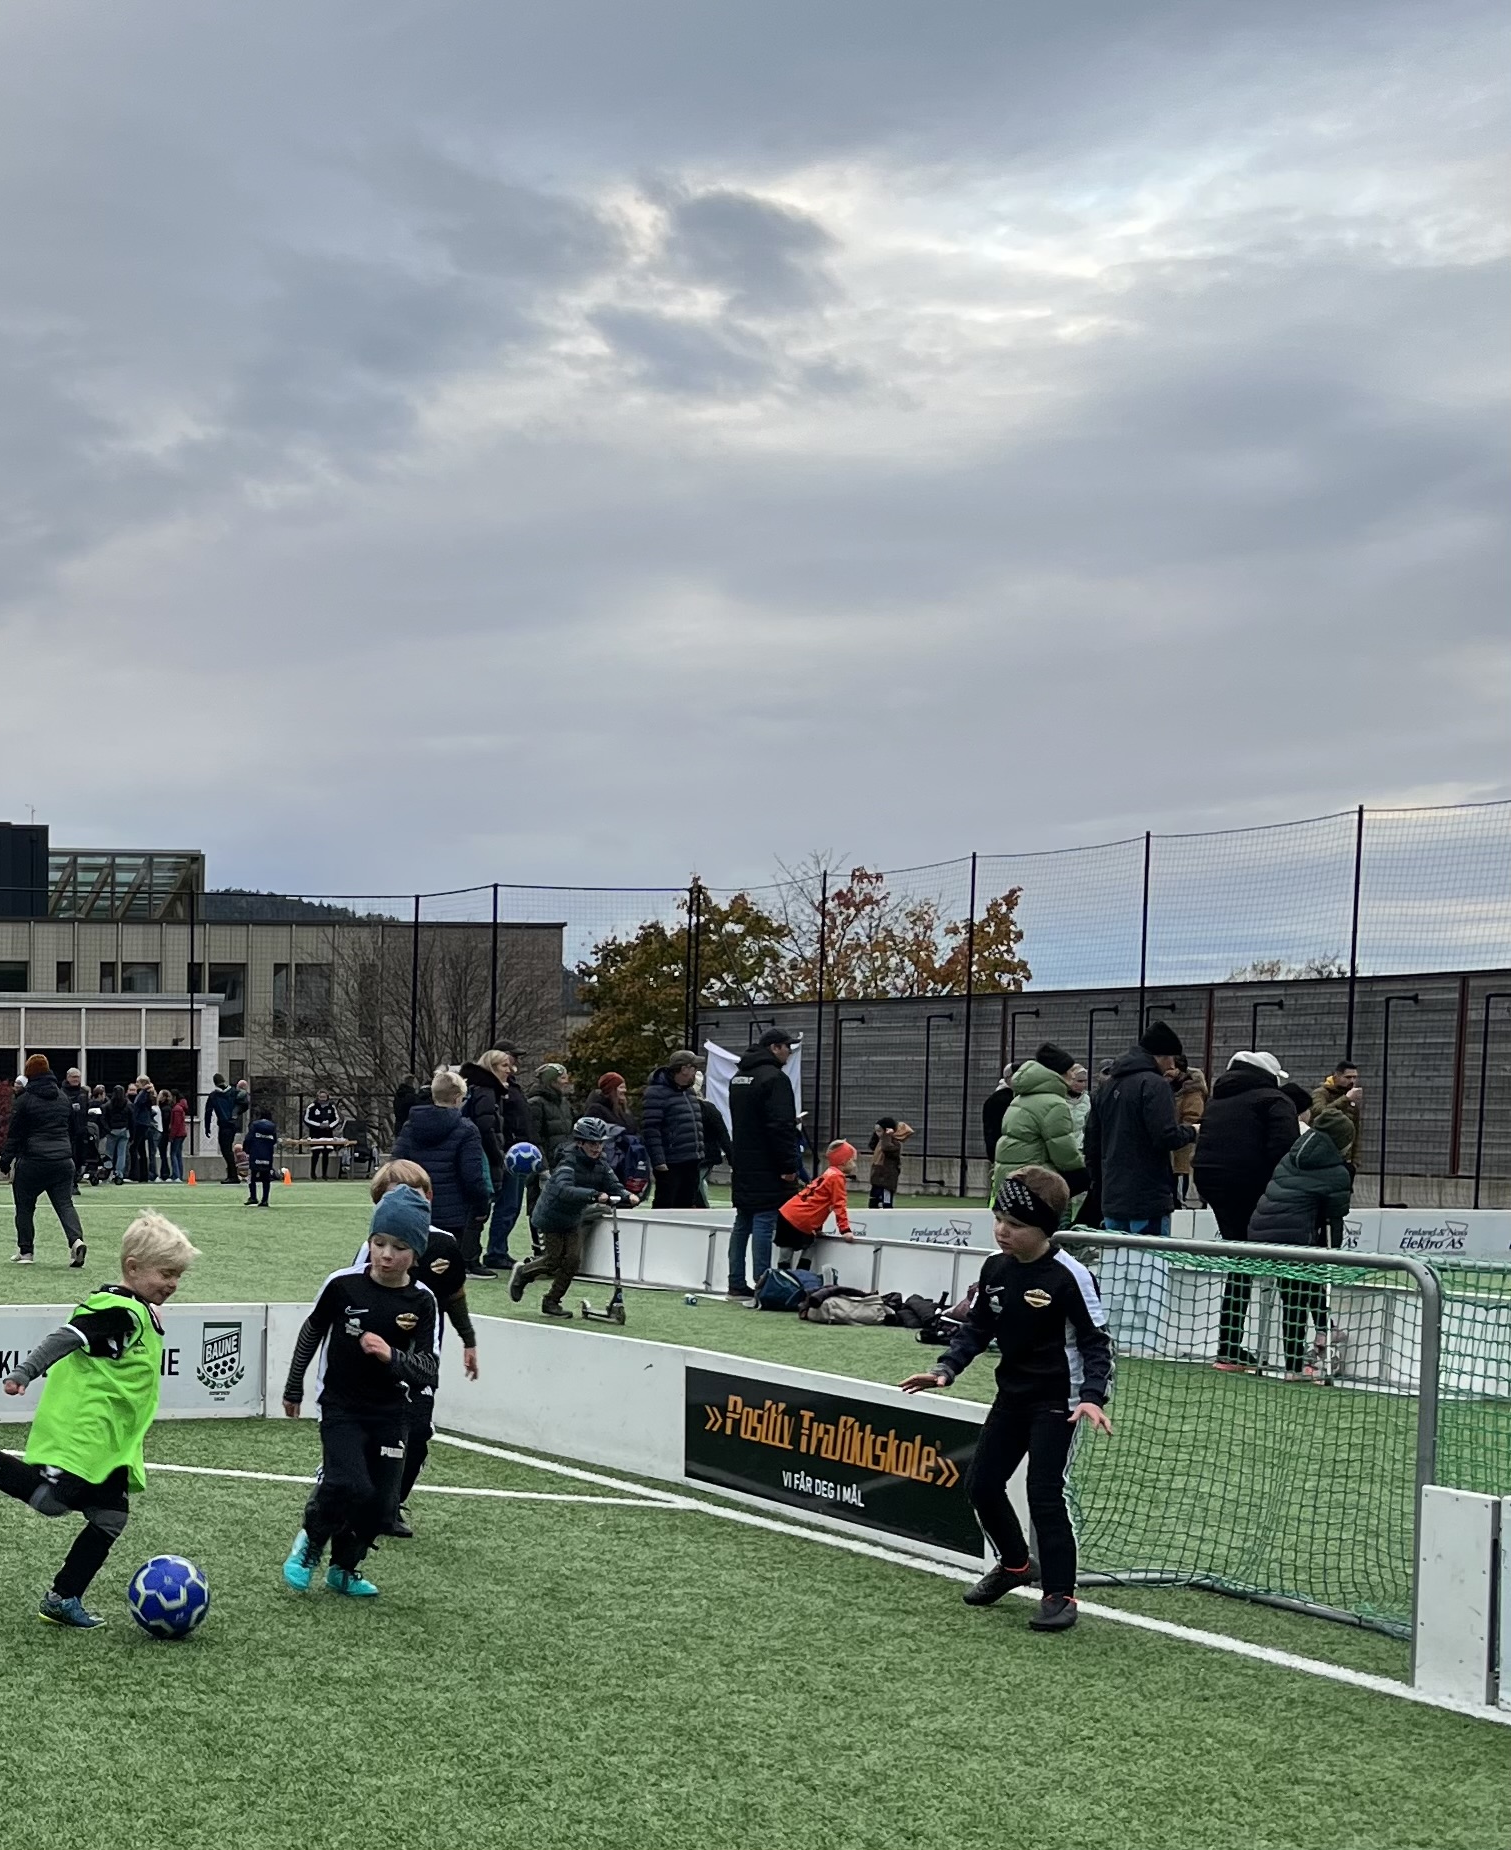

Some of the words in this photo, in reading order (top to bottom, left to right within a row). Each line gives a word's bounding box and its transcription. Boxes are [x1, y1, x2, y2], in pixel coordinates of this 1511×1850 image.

[1399, 1237, 1443, 1250] Elektro
[1444, 1237, 1465, 1250] AS
[205, 1334, 238, 1362] BAUNE
[782, 1470, 793, 1488] VI
[793, 1471, 813, 1494] FÅR
[814, 1479, 835, 1500] DEG
[842, 1483, 865, 1508] MÅL
